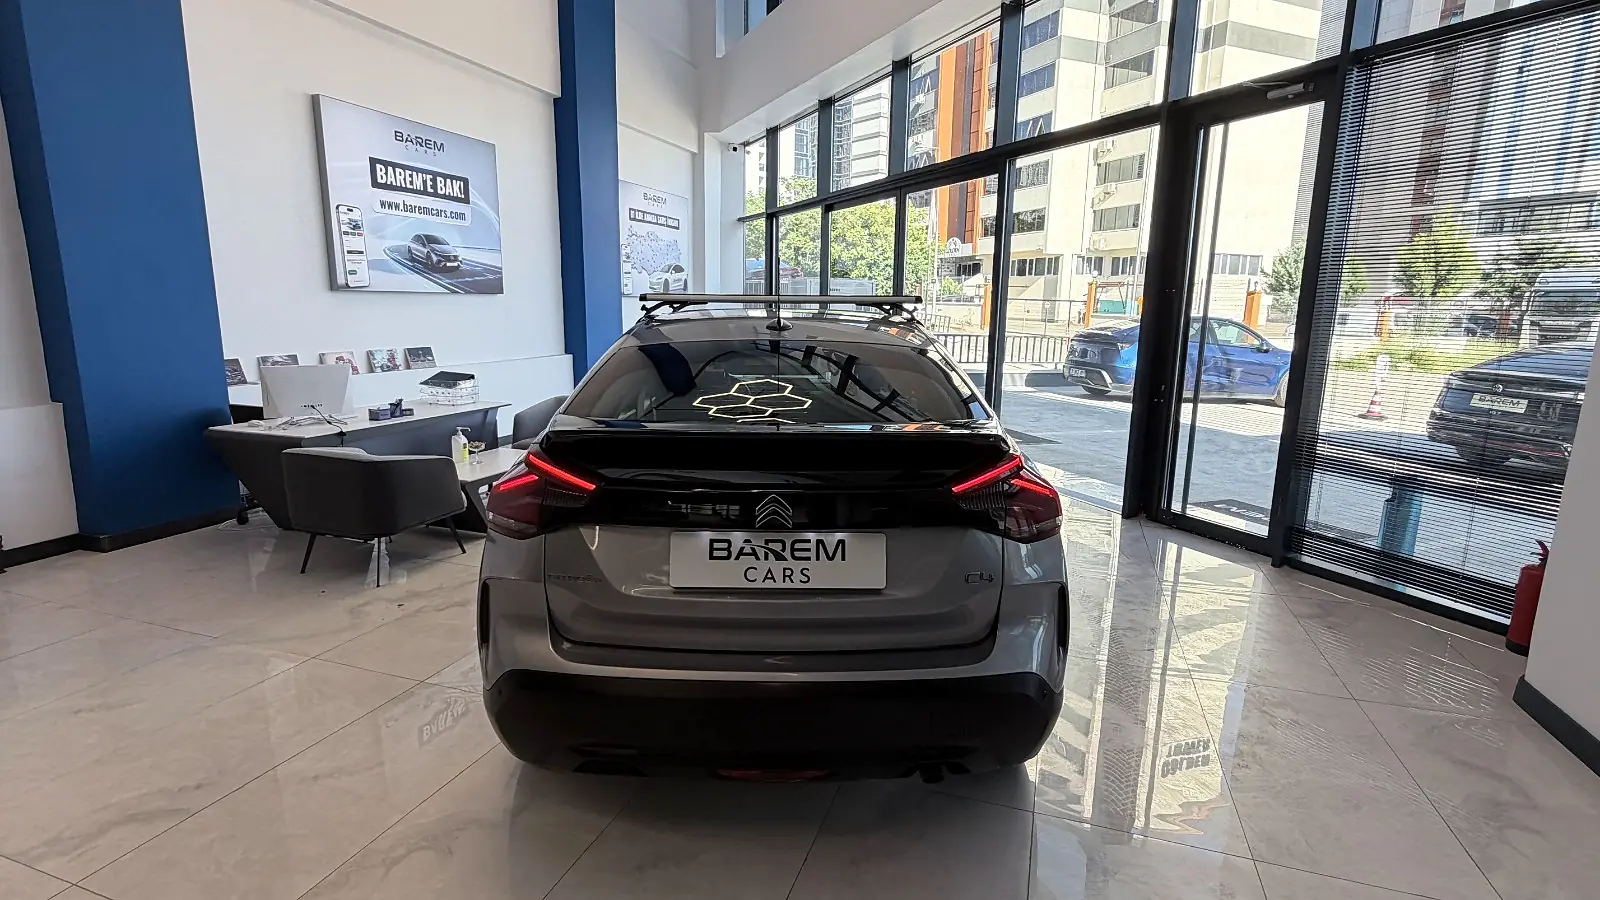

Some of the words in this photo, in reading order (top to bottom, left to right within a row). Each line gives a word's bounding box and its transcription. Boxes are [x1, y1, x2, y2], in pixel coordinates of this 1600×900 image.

[394, 130, 445, 153] BAREM
[404, 145, 437, 157] CARS
[375, 163, 433, 193] BAREM'E
[436, 178, 465, 199] BAK!
[643, 192, 667, 205] BAREM
[379, 198, 466, 222] www.baremcars.com
[1478, 395, 1521, 407] BAREM
[708, 537, 847, 563] BAREM
[743, 565, 811, 585] CARS
[965, 571, 995, 584] C4
